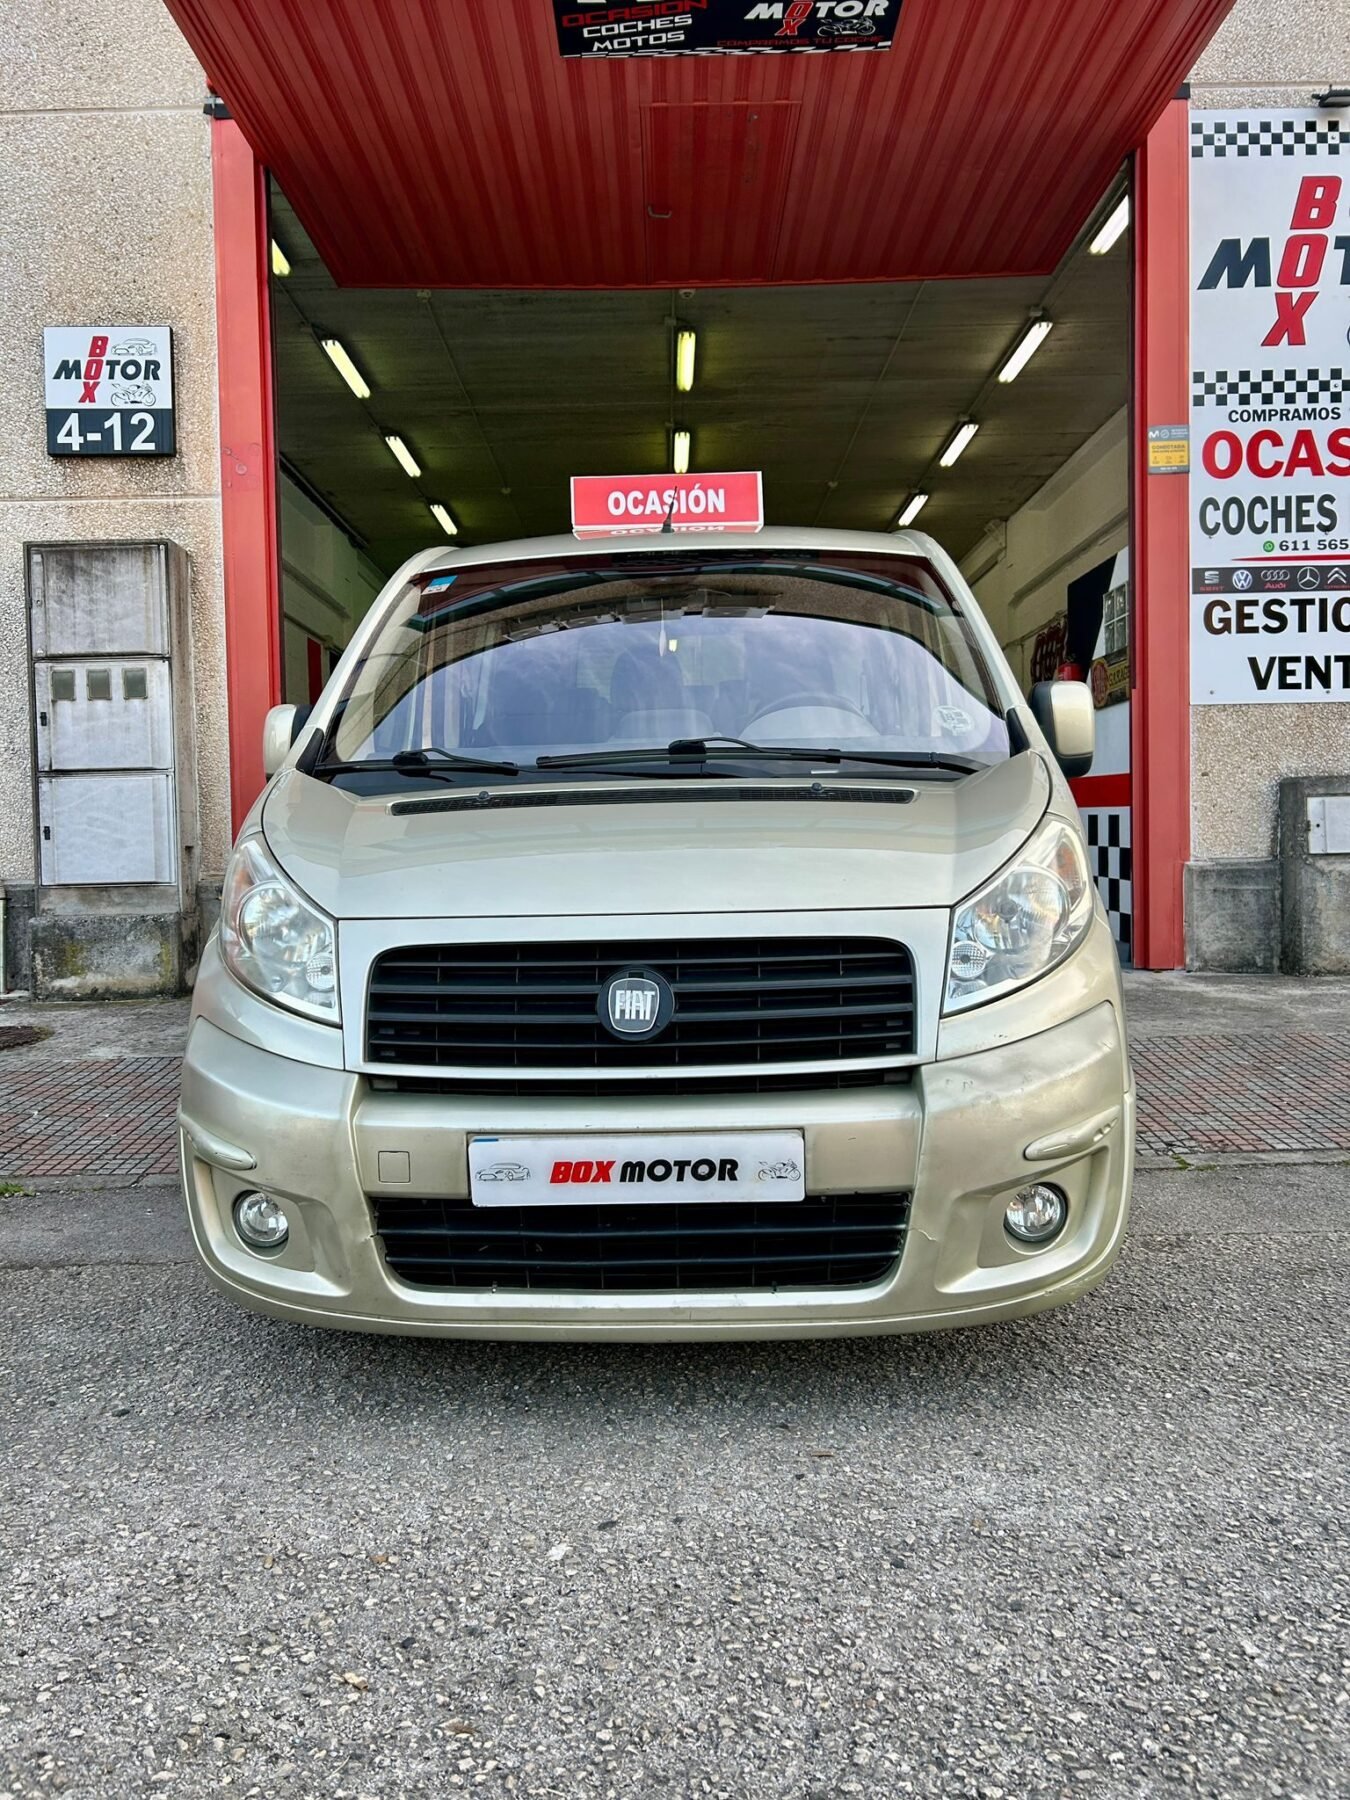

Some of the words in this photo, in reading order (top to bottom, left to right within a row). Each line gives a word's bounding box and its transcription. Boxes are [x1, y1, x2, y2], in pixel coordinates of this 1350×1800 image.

[582, 14, 693, 38] COCHES
[592, 30, 685, 51] MOTOS
[717, 37, 810, 47] COMPRAMOS
[813, 36, 833, 44] TU
[834, 35, 884, 43] COCHE
[1261, 175, 1342, 346] BOX
[52, 359, 161, 380] MOTOR
[78, 336, 109, 403] BOX
[1228, 407, 1341, 423] COMPRAMOS
[56, 411, 156, 451] 4-12
[1202, 427, 1350, 479] OCAS
[607, 483, 726, 516] OCASIÓN
[1199, 494, 1338, 536] COCHES
[1279, 540, 1310, 552] 611
[1317, 538, 1350, 551] 565
[1247, 655, 1350, 690] VENT
[615, 990, 656, 1020] FIAT
[550, 1160, 616, 1184] BOX
[619, 1158, 739, 1183] MOTOR
